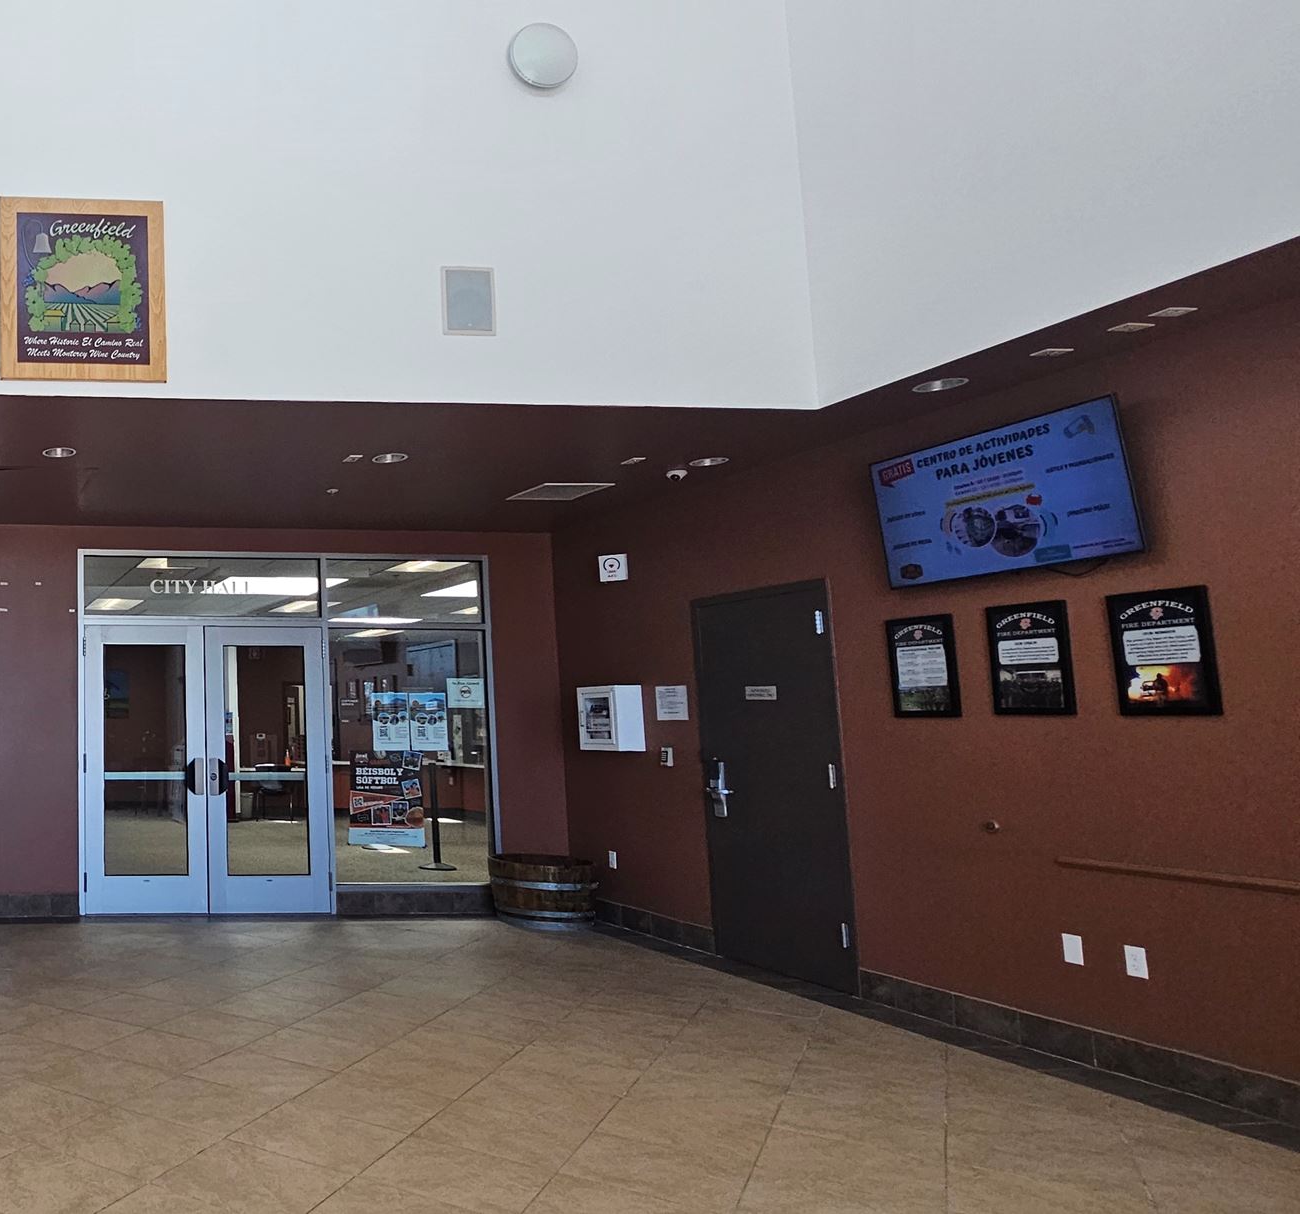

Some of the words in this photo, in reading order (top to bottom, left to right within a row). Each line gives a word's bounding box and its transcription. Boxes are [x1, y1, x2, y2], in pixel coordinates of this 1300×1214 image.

[50, 218, 136, 238] Greenfield
[24, 336, 48, 345] Where
[49, 336, 79, 346] Historic
[82, 336, 92, 346] El
[94, 338, 122, 347] Camino
[124, 338, 144, 347] Real
[26, 348, 50, 356] Meets
[52, 348, 88, 358] Monterey
[89, 350, 108, 358] Wine
[110, 350, 140, 360] Country
[916, 450, 956, 468] CENTRO
[958, 445, 974, 456] DE
[976, 423, 1050, 452] ACTIVIDADES
[936, 462, 970, 480] PARA
[972, 444, 1034, 471] JÓVENES
[150, 579, 197, 594] CITY
[1120, 600, 1194, 620] GREENFIELD
[996, 612, 1055, 628] GREENFIELD
[1142, 618, 1195, 627] DEPARTMENT
